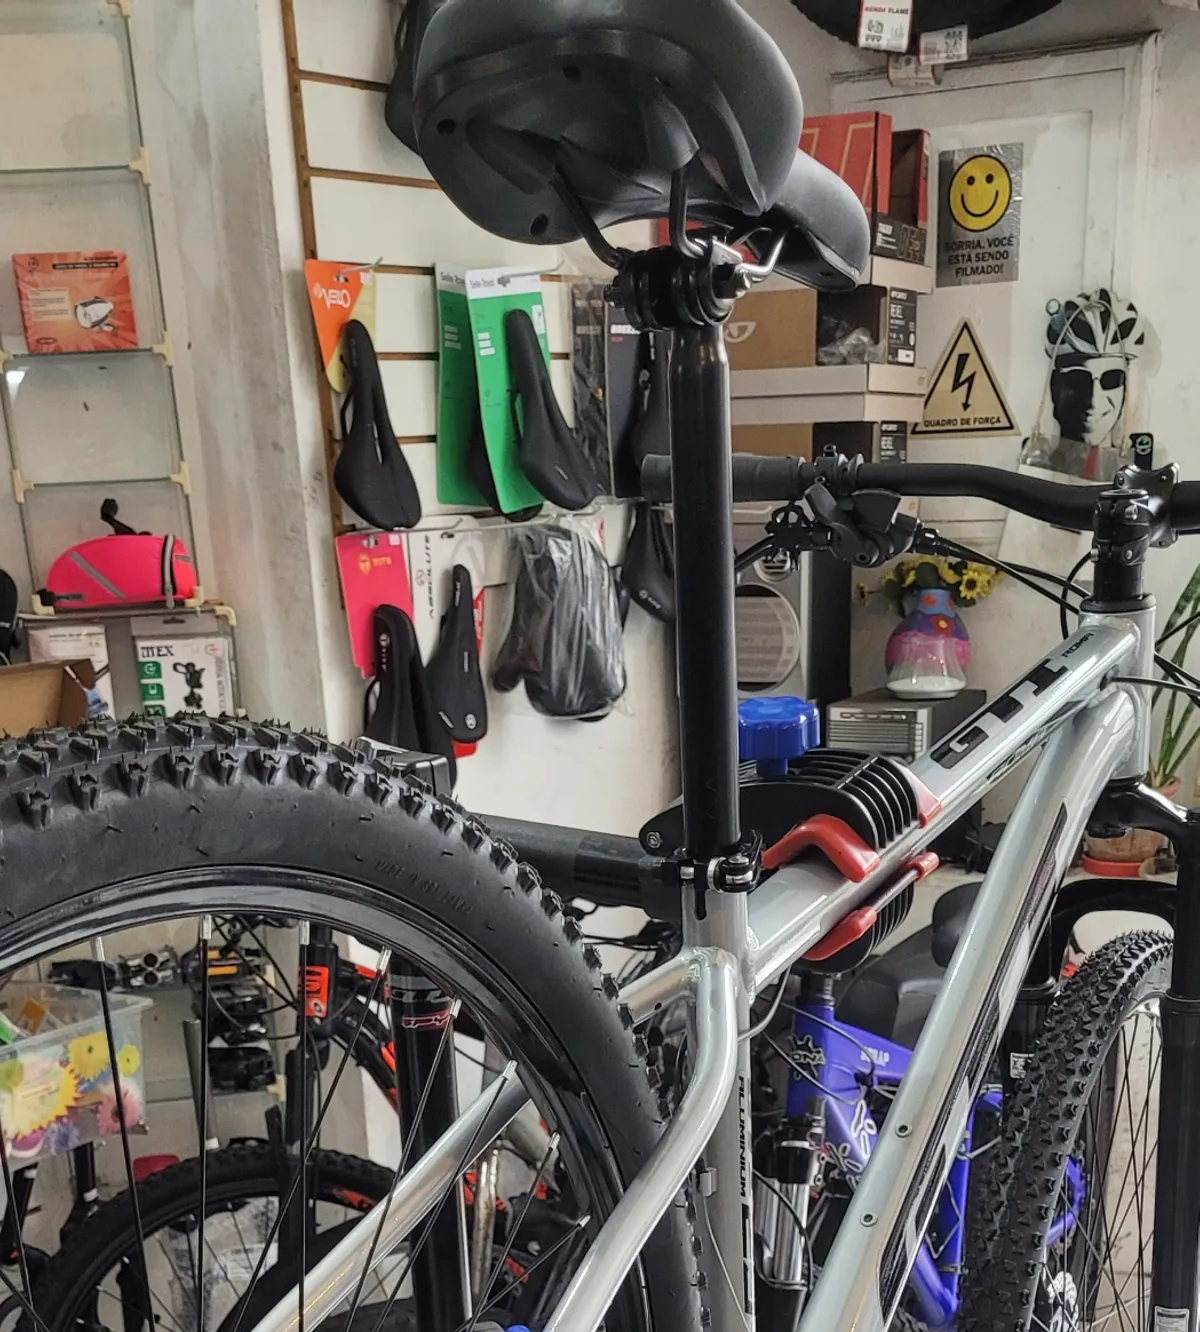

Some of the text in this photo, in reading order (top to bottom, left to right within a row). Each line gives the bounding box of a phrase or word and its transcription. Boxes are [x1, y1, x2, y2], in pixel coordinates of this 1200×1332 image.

[987, 233, 1015, 248] VOCÊ
[974, 250, 1009, 264] SENDO
[955, 263, 1005, 278] FILMADO!
[923, 415, 1001, 428] QUADRO DE FORÇA
[1061, 632, 1095, 658] ROMA
[738, 1075, 747, 1198] ALUMINIUM
